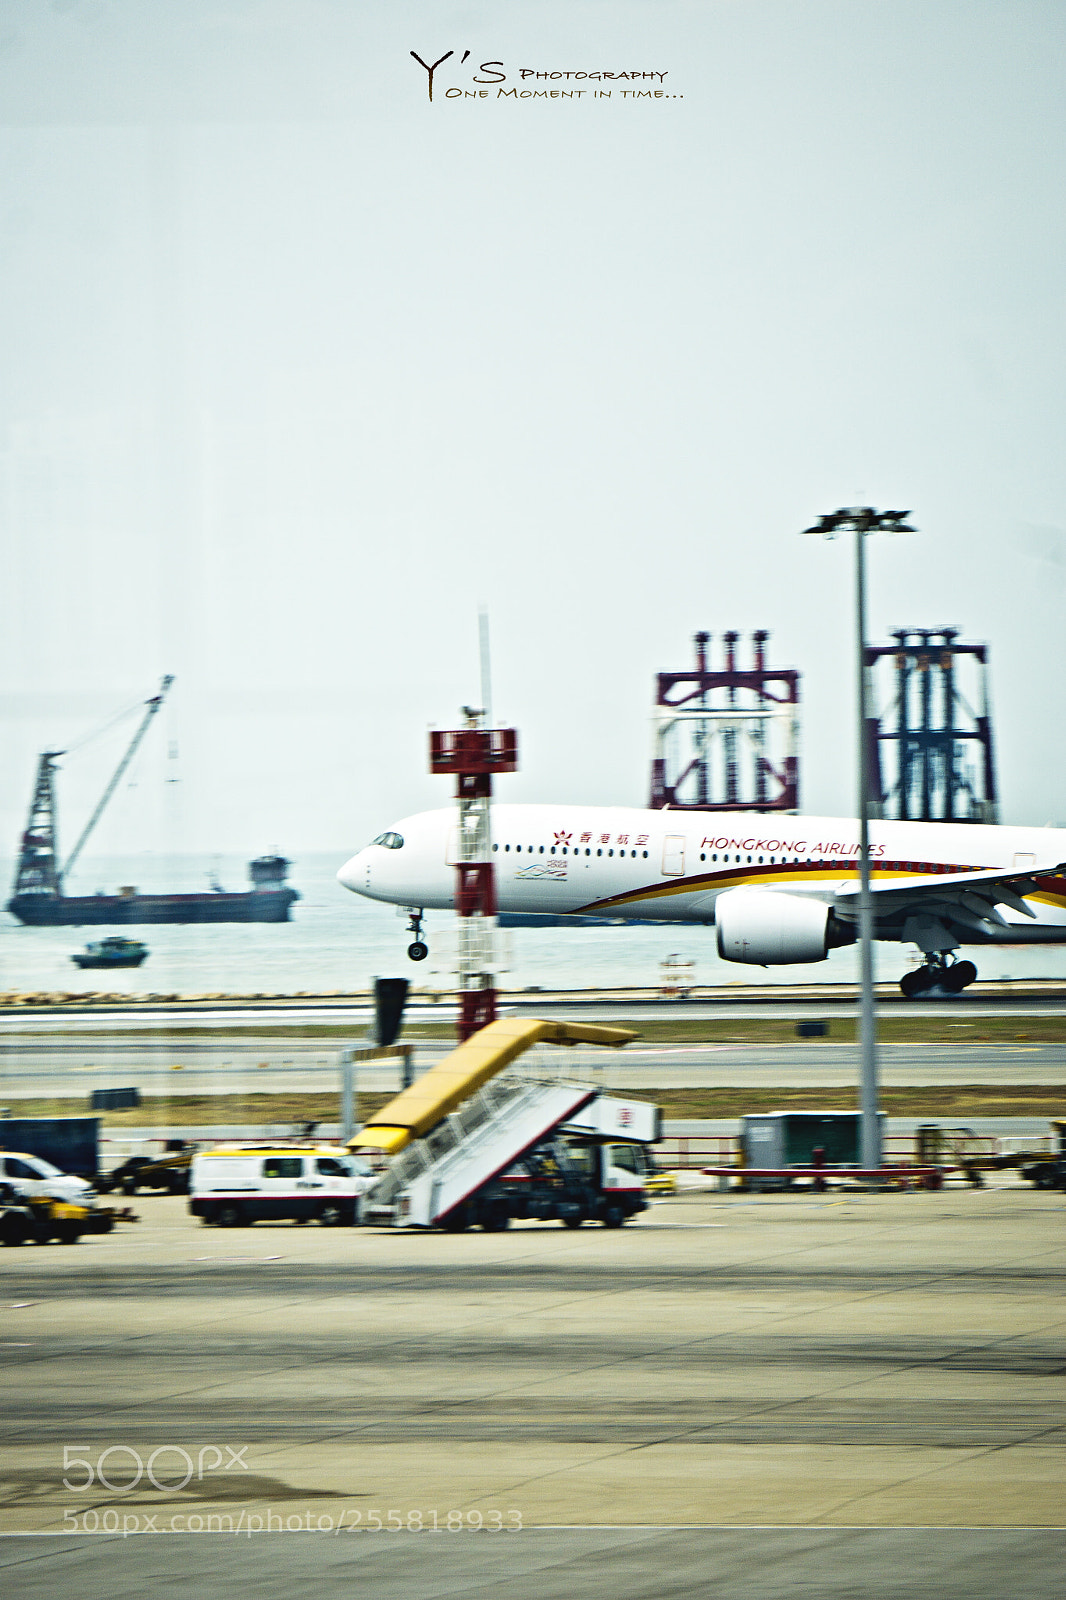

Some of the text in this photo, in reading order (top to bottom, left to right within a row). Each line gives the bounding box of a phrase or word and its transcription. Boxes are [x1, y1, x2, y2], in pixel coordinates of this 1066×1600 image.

[579, 831, 650, 846] 香港航空
[700, 836, 807, 853] HONGKONG
